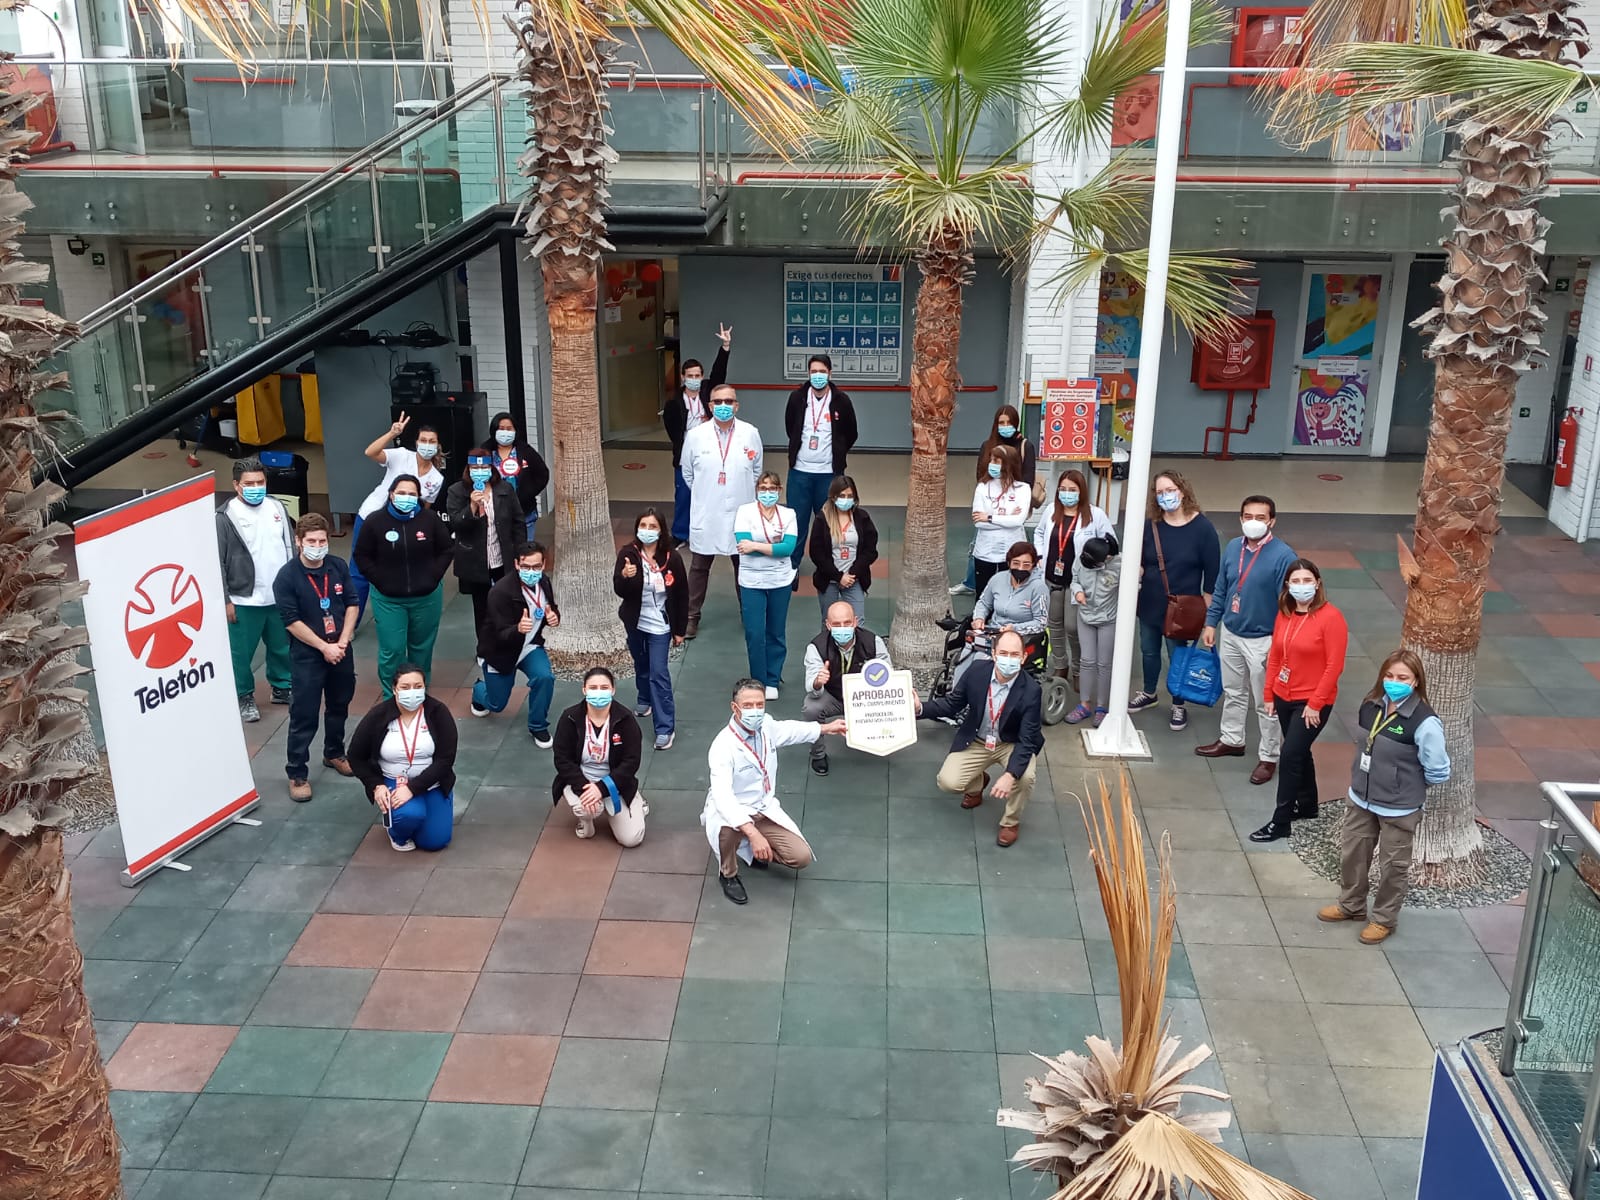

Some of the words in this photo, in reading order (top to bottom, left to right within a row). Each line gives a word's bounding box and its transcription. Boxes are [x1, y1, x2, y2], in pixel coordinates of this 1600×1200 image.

[787, 270, 812, 281] Exige
[815, 271, 829, 280] tus
[831, 270, 873, 280] derechos
[134, 658, 215, 714] Teletón
[852, 688, 904, 701] APROBADO
